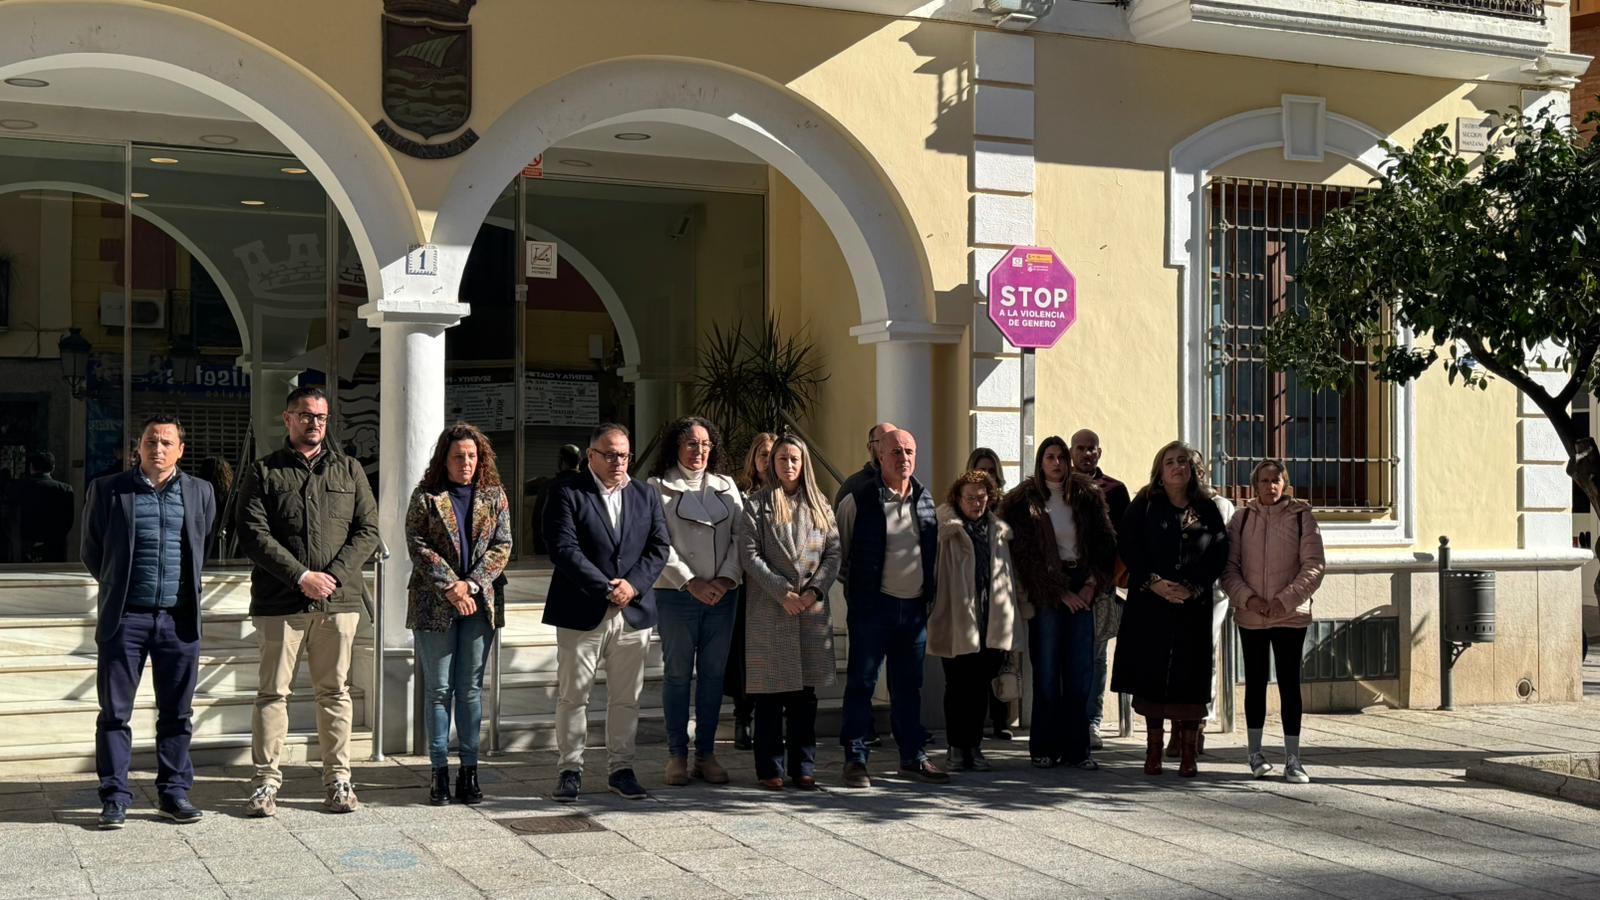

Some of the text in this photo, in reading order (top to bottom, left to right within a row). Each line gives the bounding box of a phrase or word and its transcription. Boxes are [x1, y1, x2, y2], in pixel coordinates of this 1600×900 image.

[419, 249, 426, 270] 1
[1000, 285, 1068, 309] STOP
[999, 309, 1065, 319] A LA VIOLENCIA
[1008, 319, 1056, 328] DE GENERO
